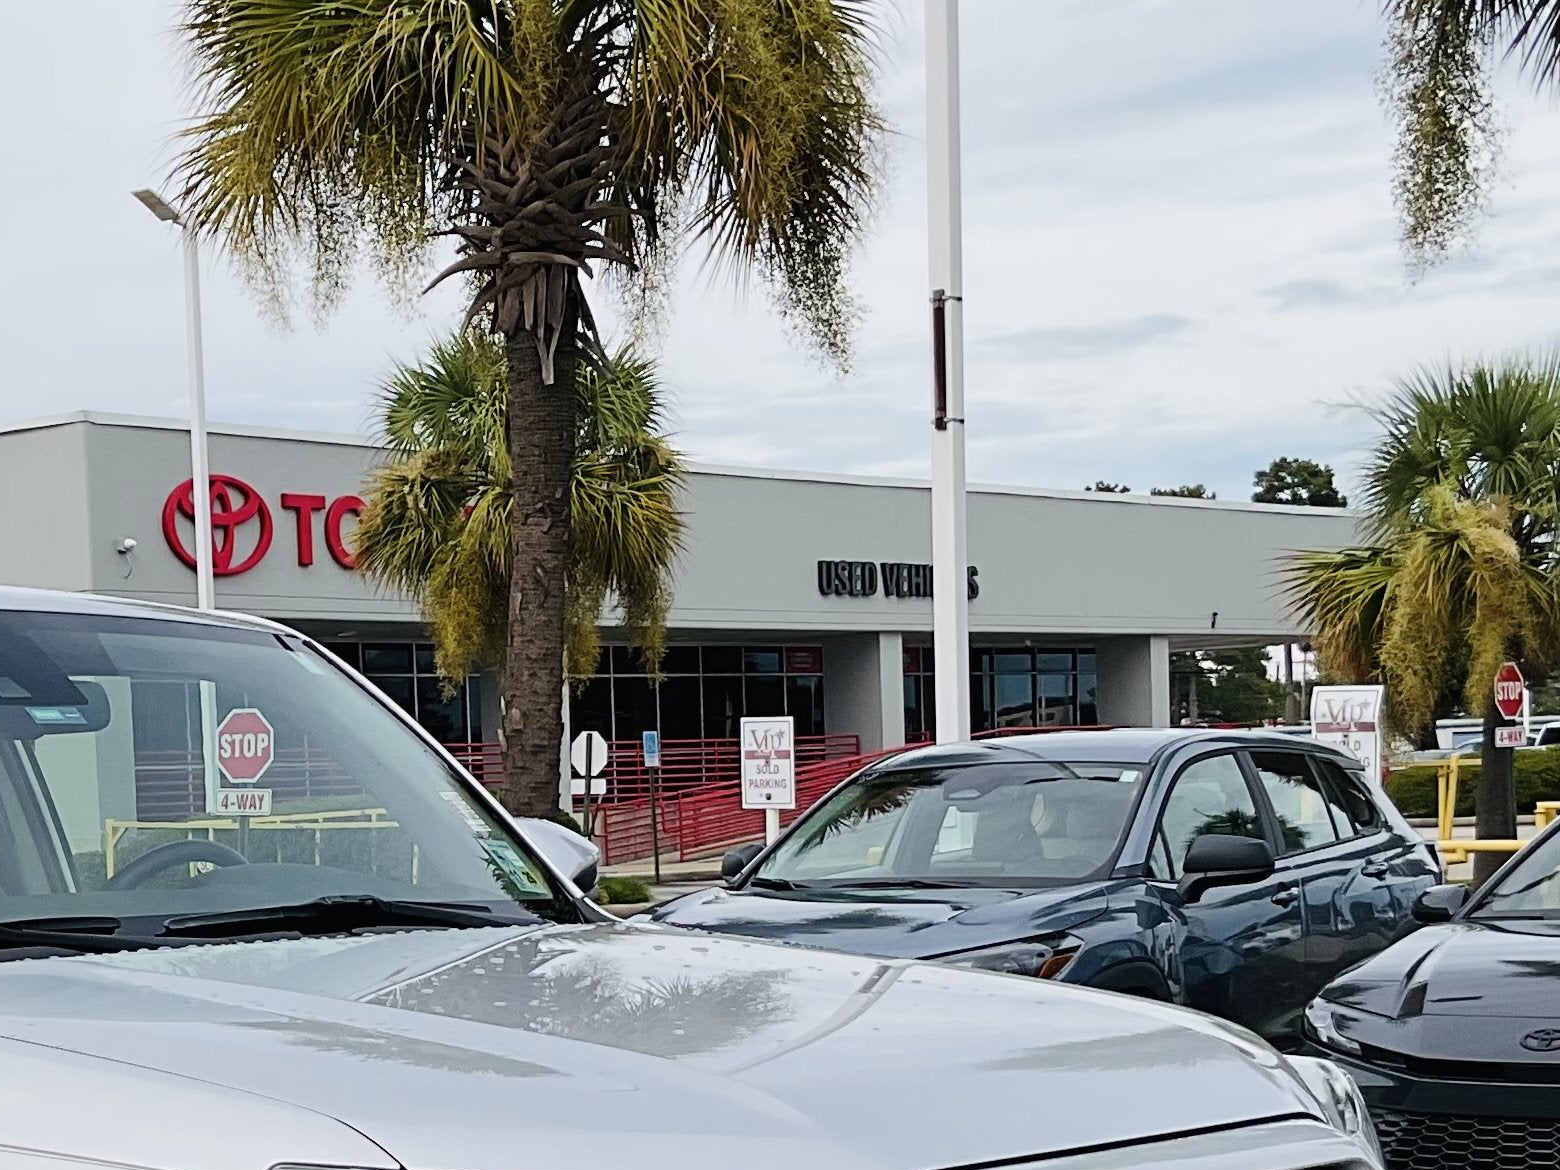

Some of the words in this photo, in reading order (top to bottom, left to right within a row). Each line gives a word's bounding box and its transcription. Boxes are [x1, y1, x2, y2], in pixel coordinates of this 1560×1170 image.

[817, 560, 878, 596] USED
[880, 562, 979, 600] VEHIS
[1497, 681, 1521, 701] STOP
[220, 733, 269, 759] STOP
[1499, 731, 1523, 744] 4-WAY
[756, 764, 780, 775] SOLD
[748, 778, 787, 789] PARKING
[221, 793, 265, 810] 4-WAY
